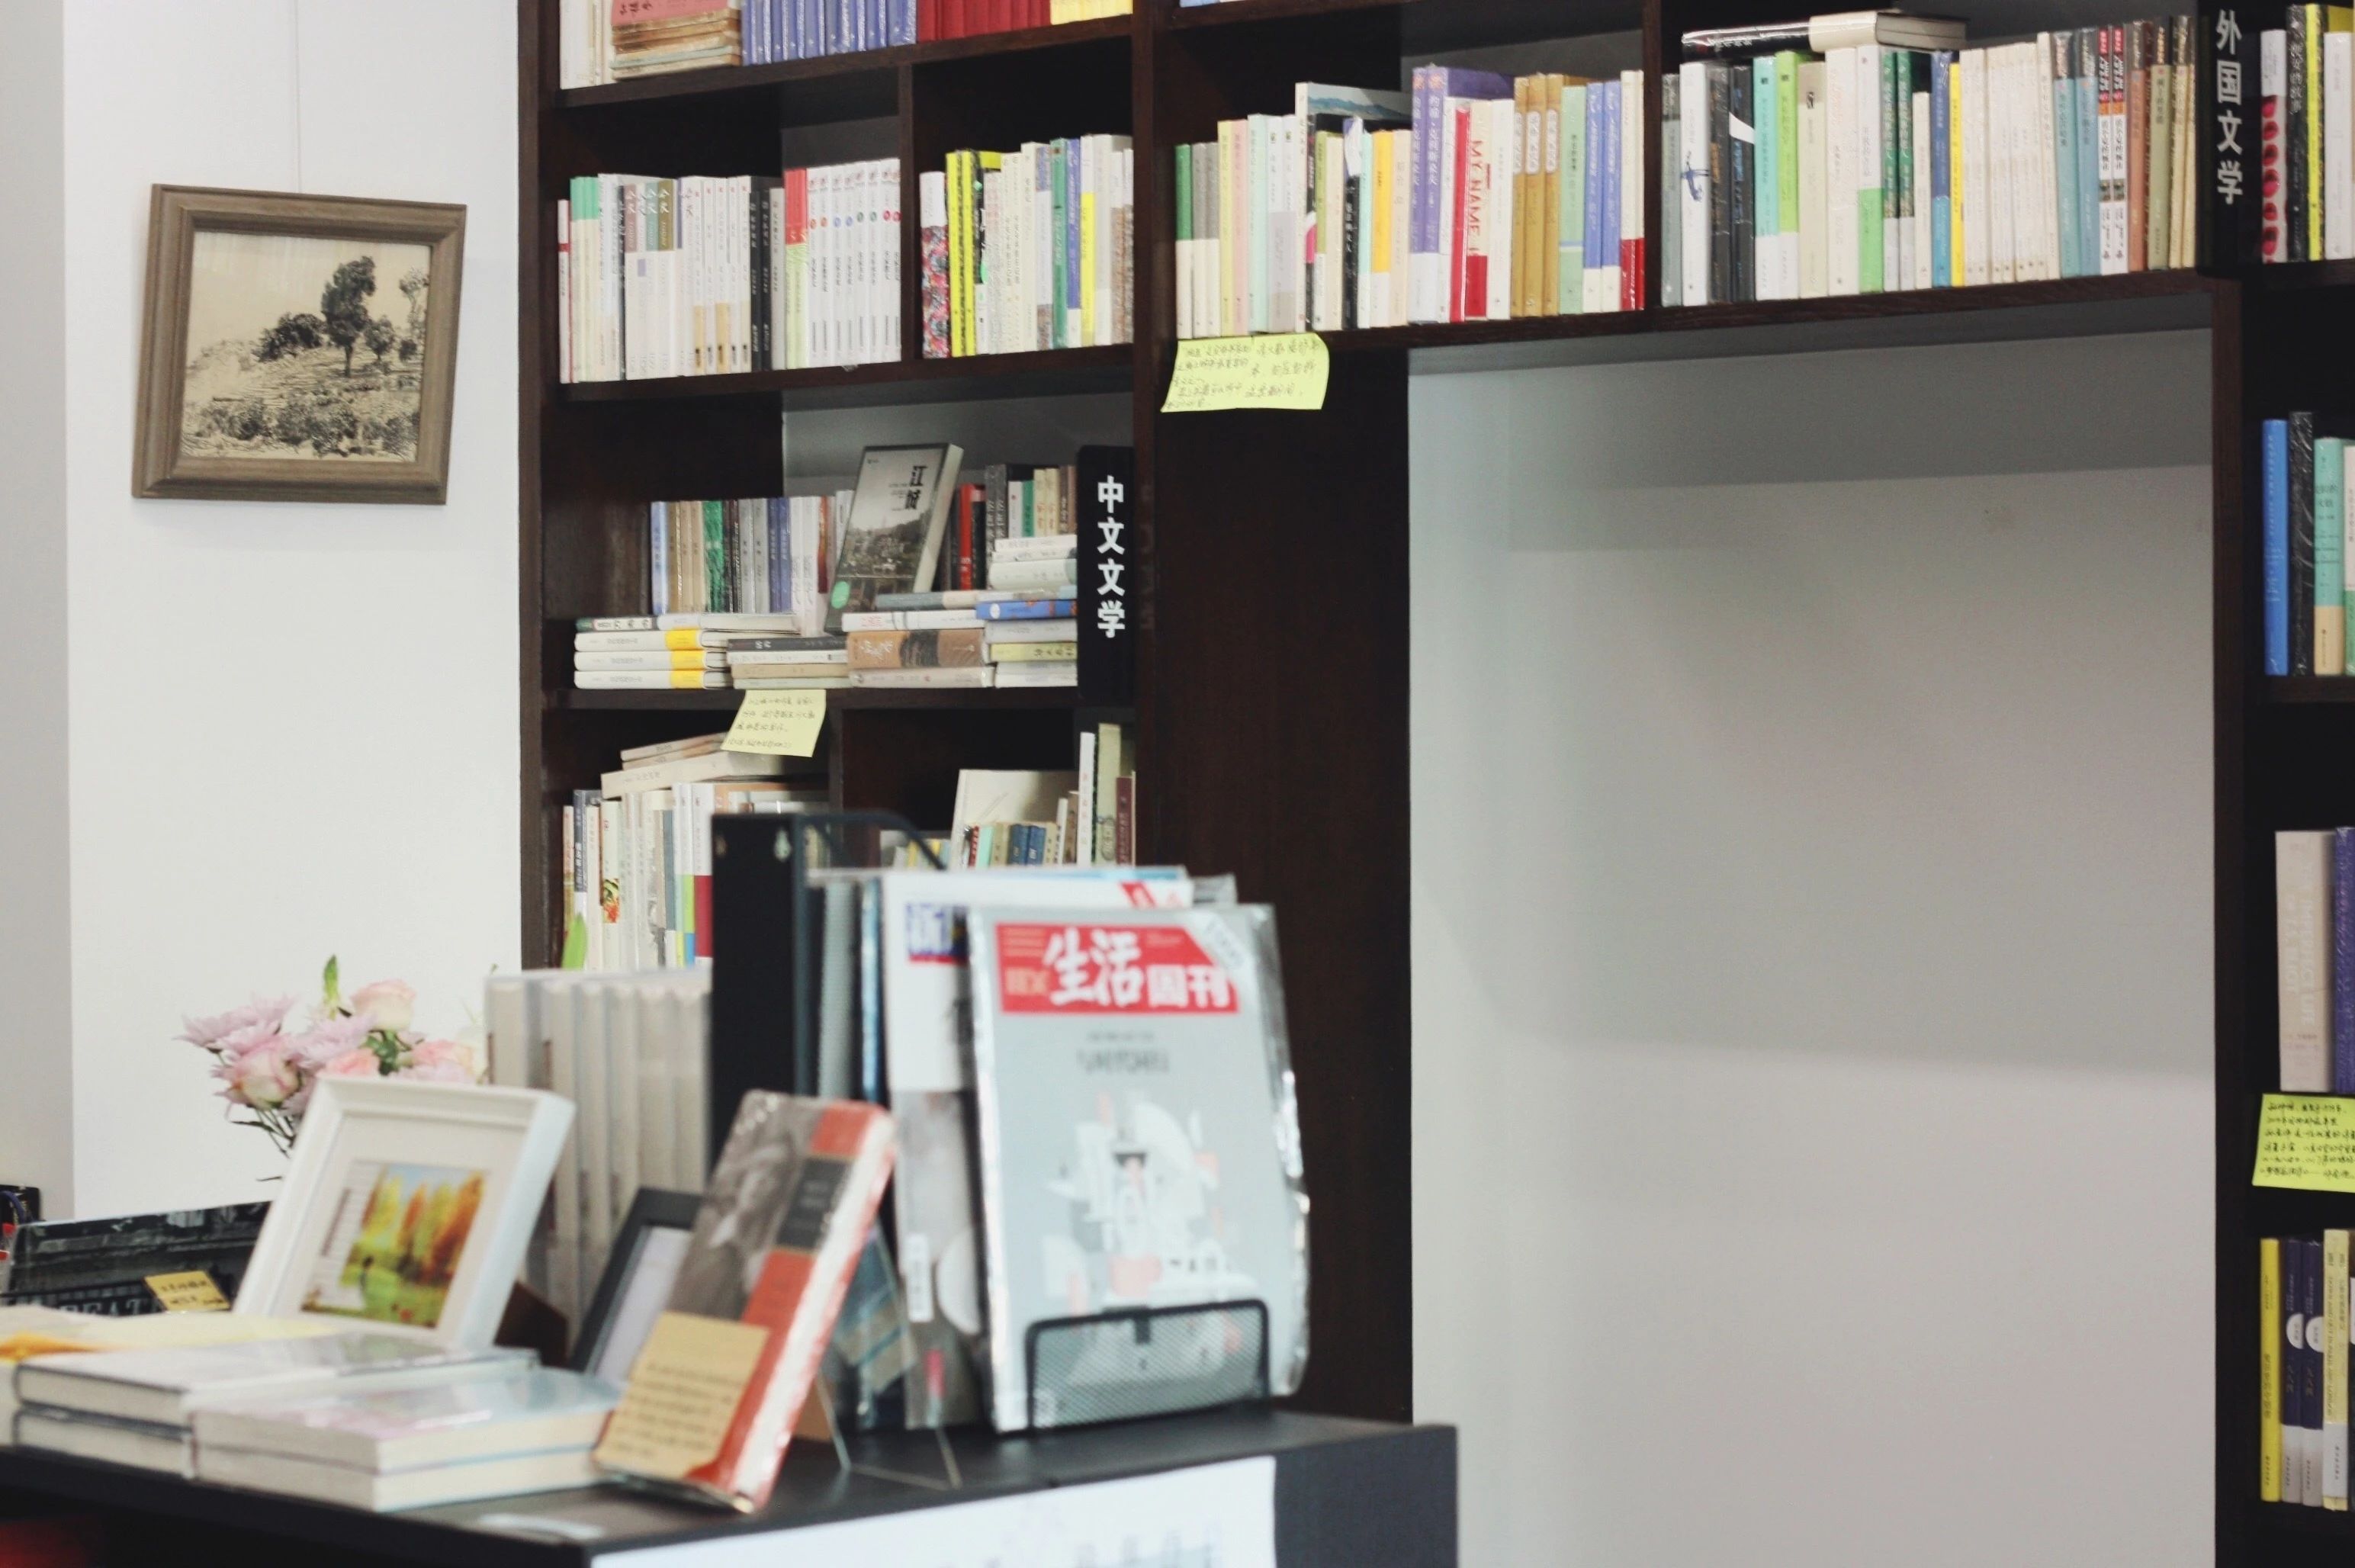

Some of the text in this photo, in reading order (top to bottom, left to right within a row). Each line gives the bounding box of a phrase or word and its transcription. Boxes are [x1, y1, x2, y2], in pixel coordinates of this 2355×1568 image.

[2216, 9, 2243, 205] 外国文学
[1471, 140, 1483, 170] MY
[1469, 179, 1482, 236] NAME
[904, 465, 928, 510] 江城
[1097, 475, 1125, 639] 中文文学
